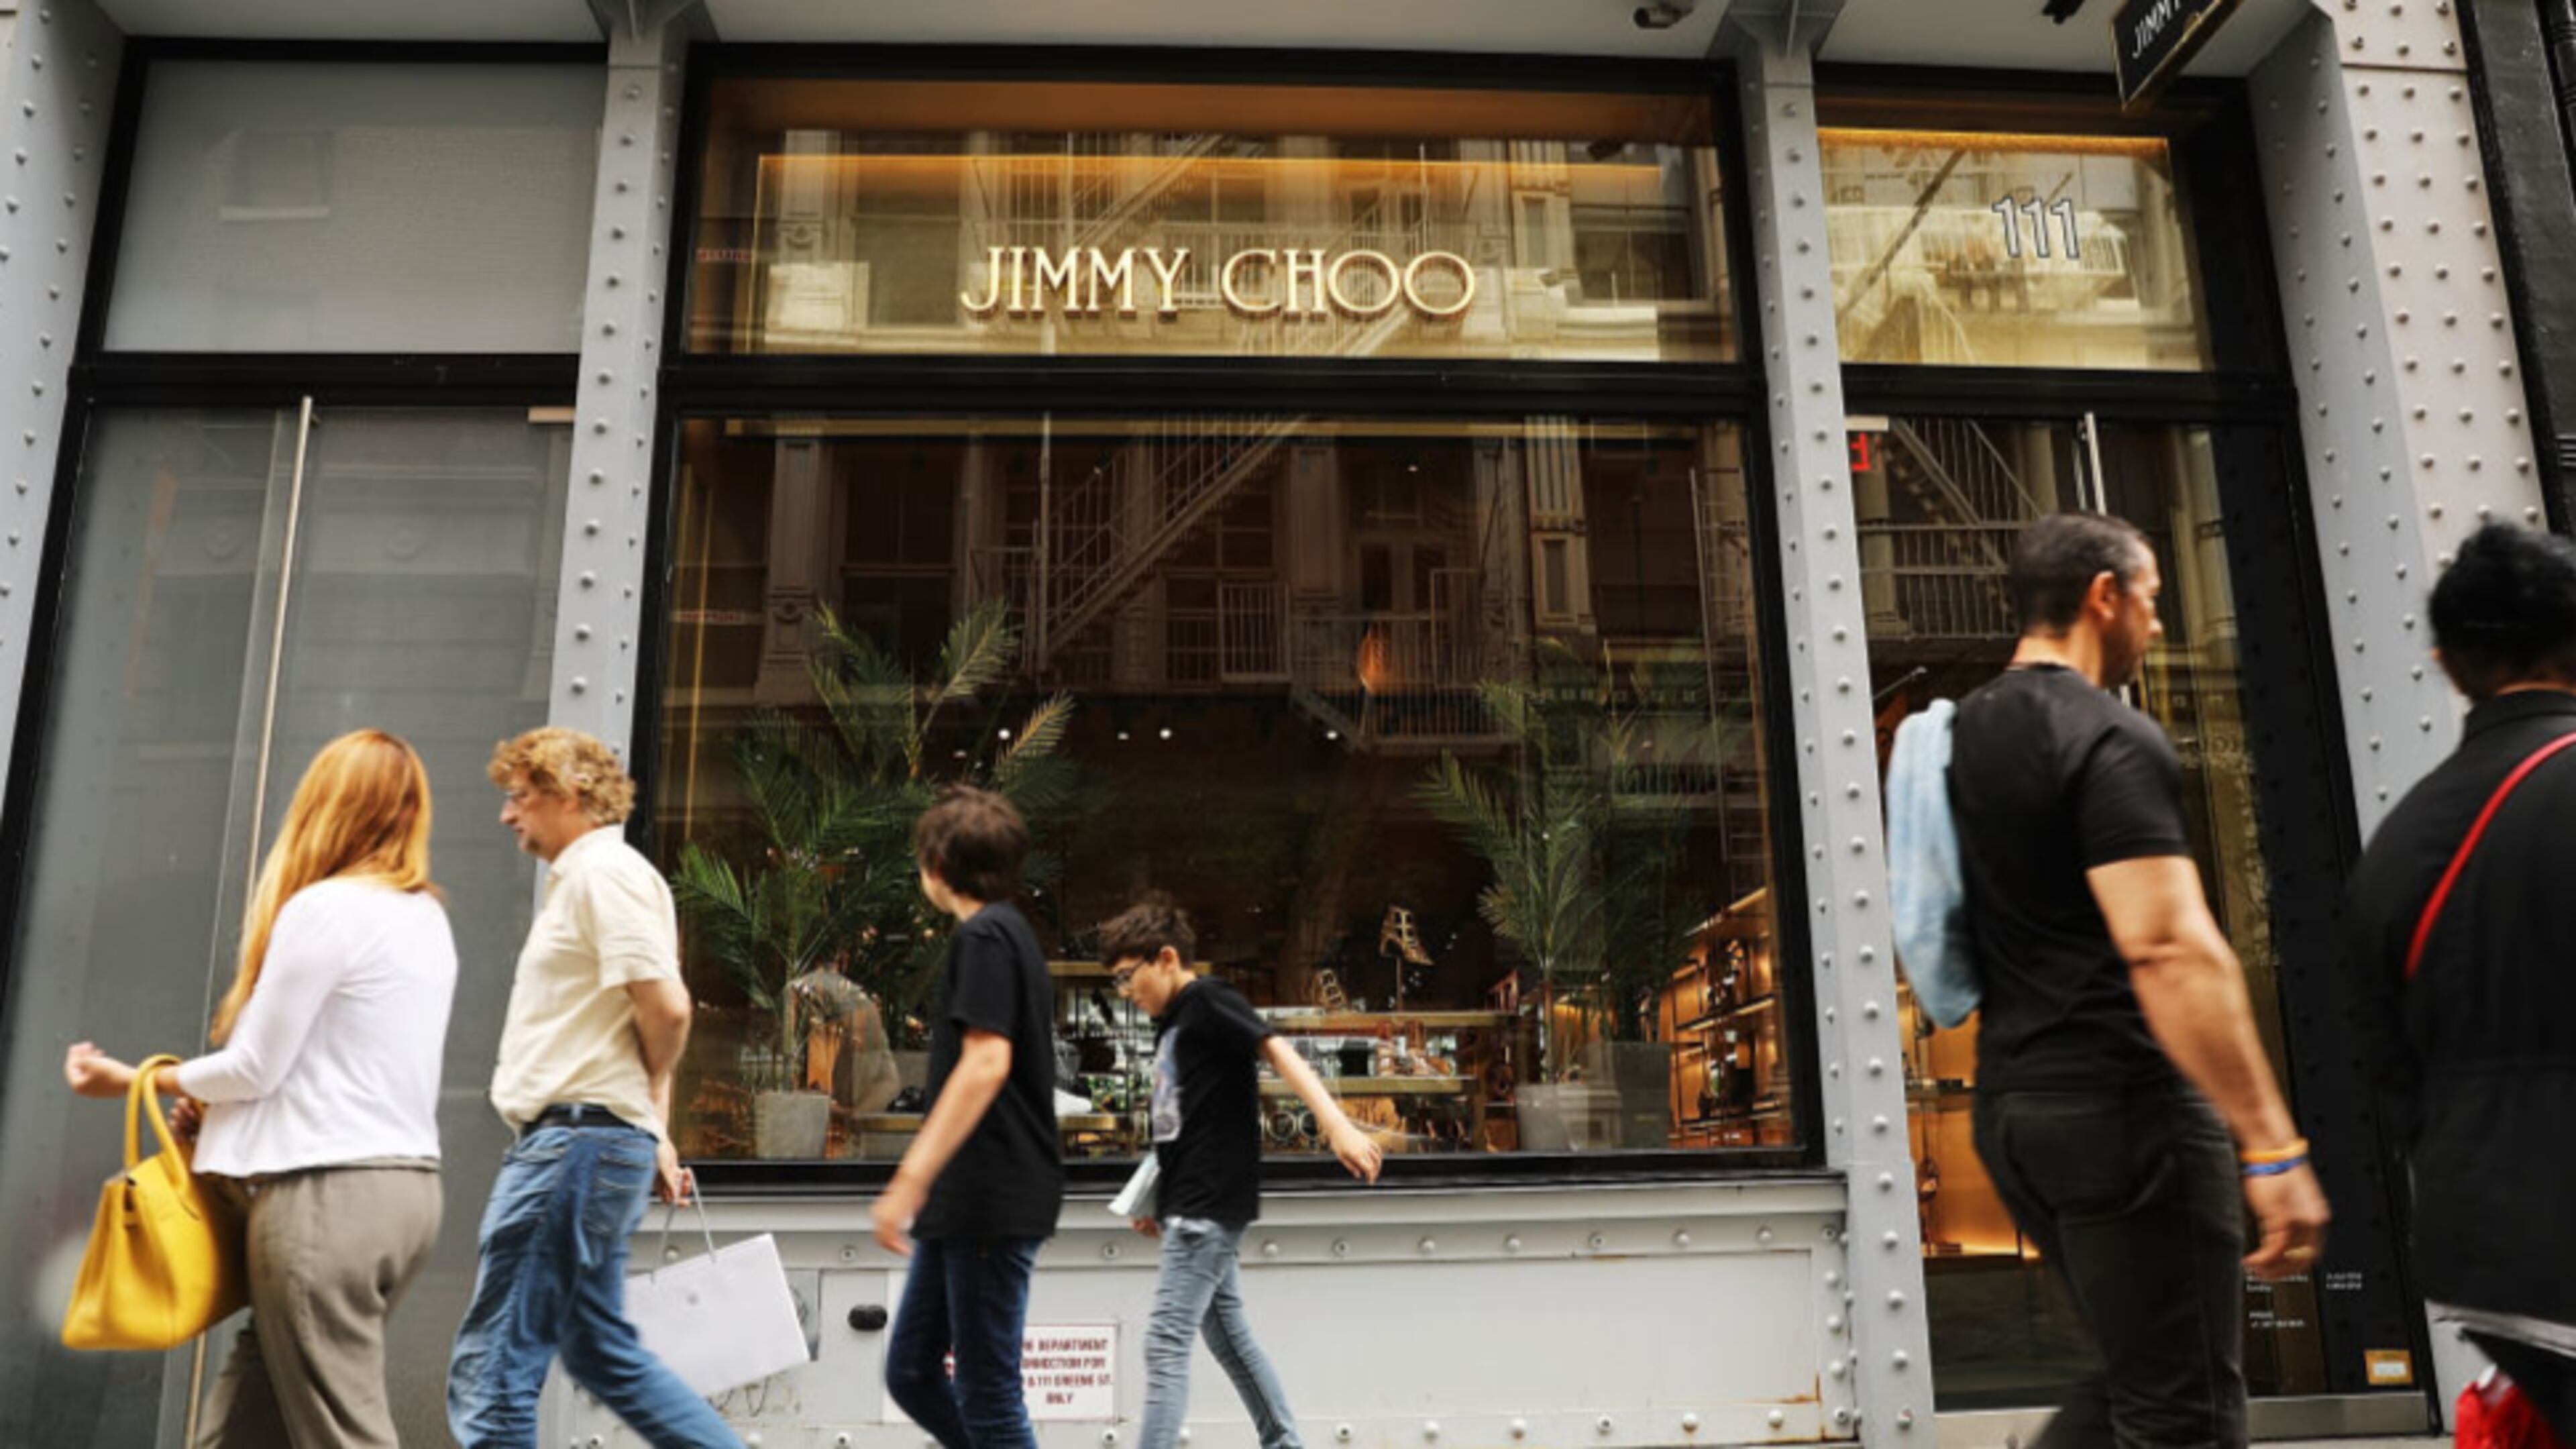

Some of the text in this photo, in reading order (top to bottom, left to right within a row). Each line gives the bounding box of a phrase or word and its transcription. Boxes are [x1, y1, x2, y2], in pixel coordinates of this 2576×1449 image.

[1991, 195, 2080, 259] 111
[960, 246, 1477, 318] JIMMY CHOO
[1038, 1338, 1108, 1352] DEPARTMENT
[1020, 1356, 1106, 1370] ONNECTION FOR
[1054, 1374, 1094, 1387] GREENE
[1045, 1392, 1074, 1405] ONLY
